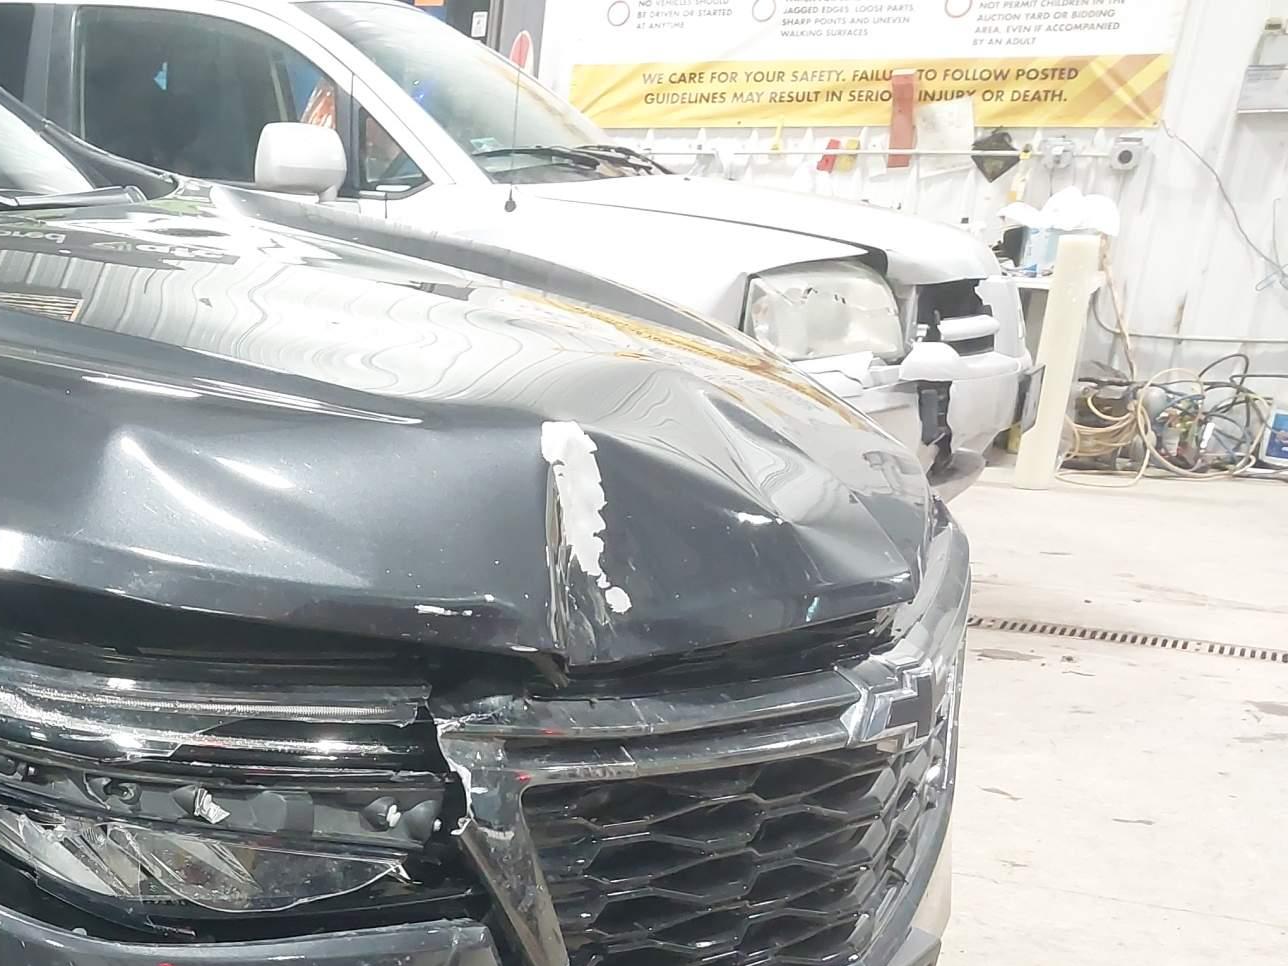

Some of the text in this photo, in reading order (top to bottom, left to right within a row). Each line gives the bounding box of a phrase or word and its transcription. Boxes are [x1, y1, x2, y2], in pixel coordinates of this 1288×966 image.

[783, 5, 819, 14] JAGGED
[855, 4, 883, 12] LOOSE
[978, 1, 1001, 9] NOT
[1003, 0, 1037, 8] PERMIT
[636, 8, 733, 19] BE DRIVEN OR STARTED
[976, 8, 1116, 21] AUCTION YARD OR BIDDING
[635, 21, 646, 29] AT
[781, 15, 910, 26] SHARP POINTS AND UNEVEN
[780, 28, 869, 37] WALKING SURFACES
[1006, 24, 1031, 33] EVEN
[1033, 24, 1043, 32] IF
[1046, 21, 1121, 32] ACCOMPANIED
[972, 37, 984, 46] BY
[987, 37, 1002, 46] AN
[642, 67, 1080, 84] WE CARE FOR YOUR SAFETY. FAILU TO FOLLOW POSTED
[644, 91, 727, 104] GUIDELINES
[732, 91, 765, 104] MAY
[769, 90, 821, 103] RESULT
[825, 90, 843, 102] IN
[848, 90, 893, 102] SERIO
[982, 89, 1005, 102] OR
[1010, 89, 1069, 102] DEATH.
